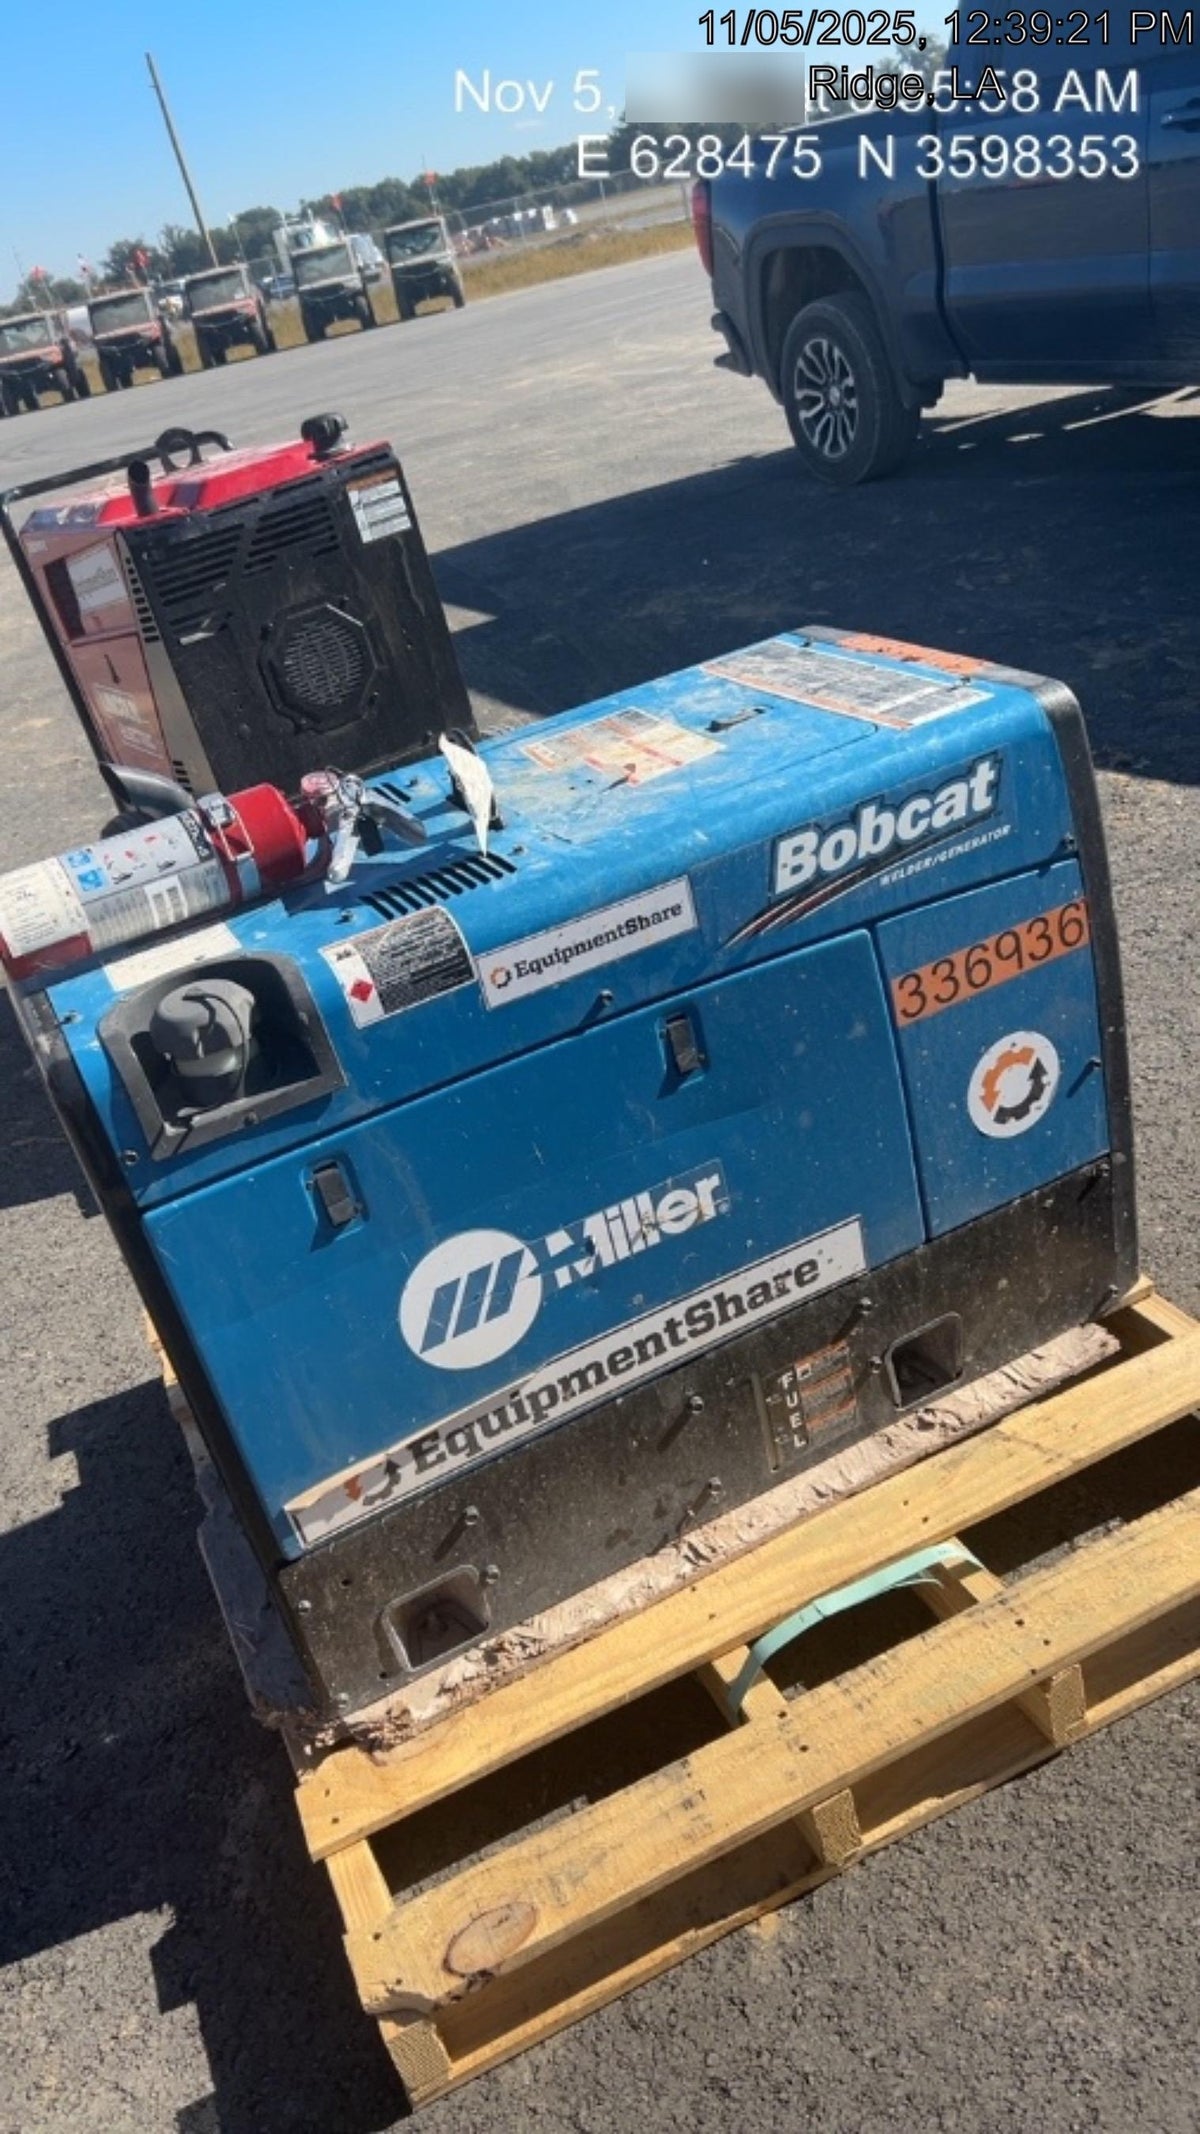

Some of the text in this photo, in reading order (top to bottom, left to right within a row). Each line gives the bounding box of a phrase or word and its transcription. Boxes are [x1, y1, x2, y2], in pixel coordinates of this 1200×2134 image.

[774, 759, 997, 896] Bobcat
[513, 901, 684, 980] EquipmentShare
[898, 902, 1085, 1019] 336936
[544, 1173, 721, 1289] Miller
[411, 1254, 820, 1474] EquipmentShare
[780, 1370, 807, 1449] FUEL
